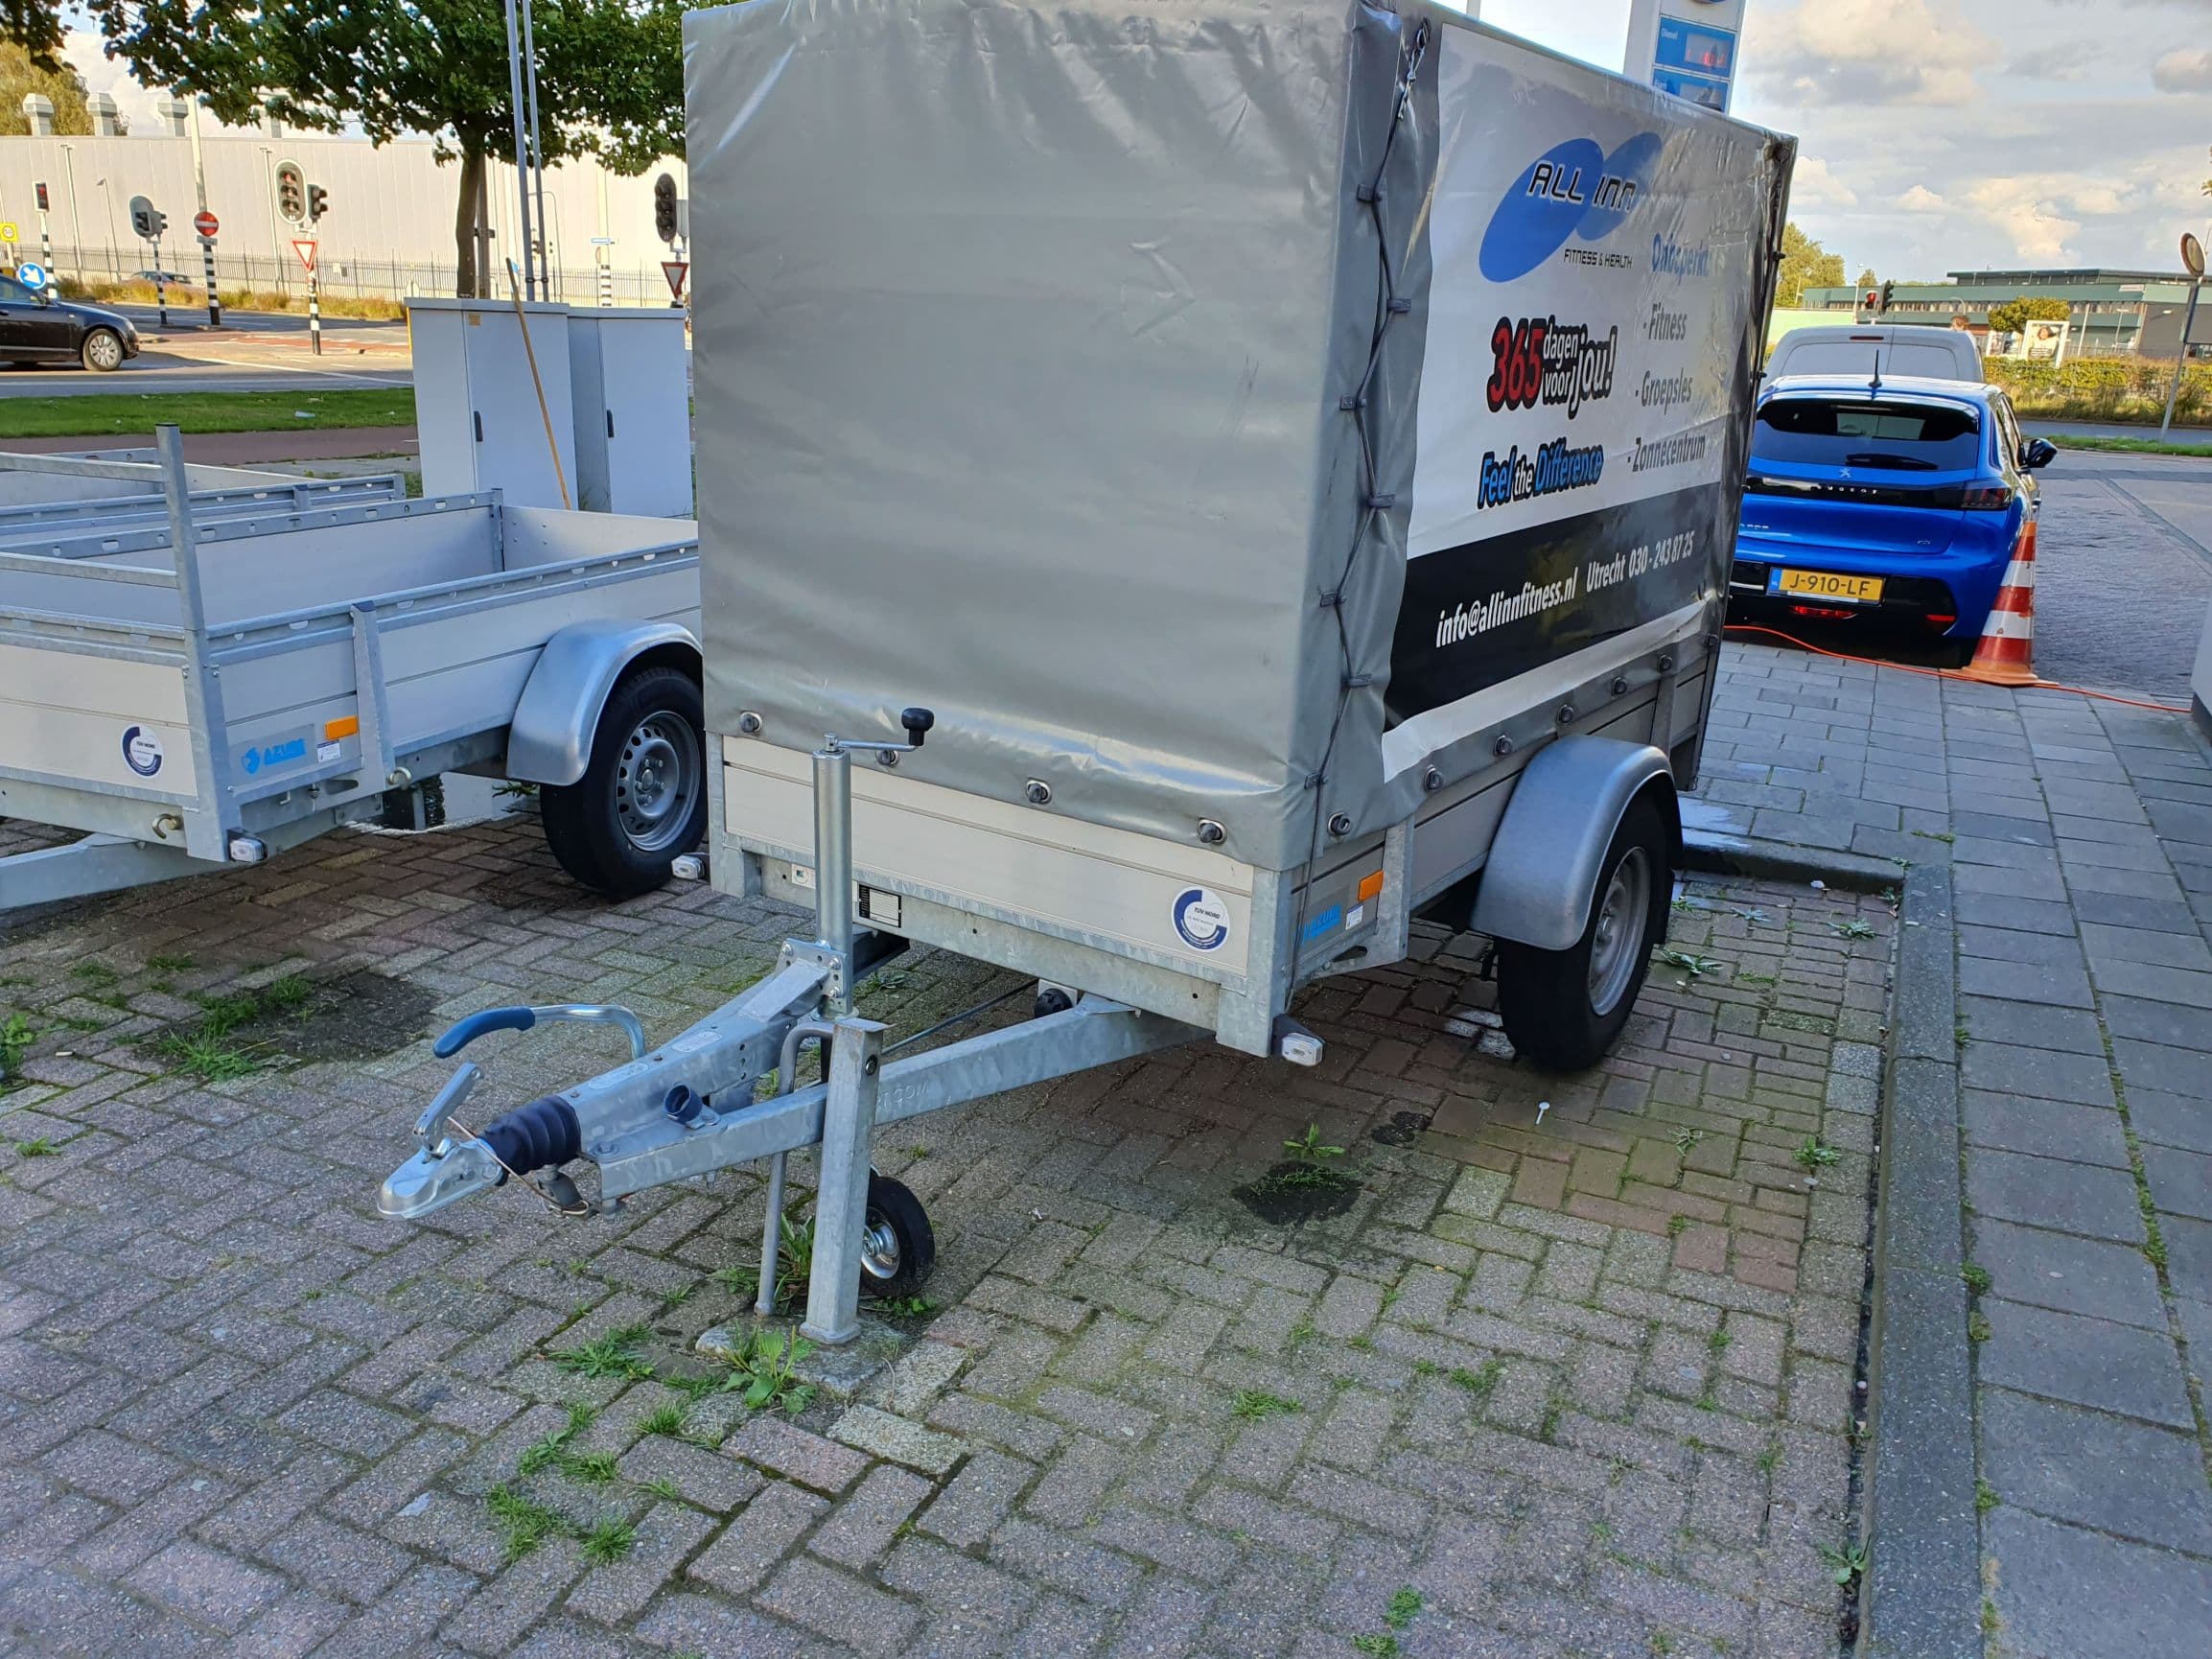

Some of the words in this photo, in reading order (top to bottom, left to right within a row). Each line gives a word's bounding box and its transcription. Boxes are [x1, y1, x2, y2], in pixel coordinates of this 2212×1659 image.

[1527, 161, 1583, 203] ALL
[1604, 253, 1633, 269] HEALTH
[1648, 302, 1688, 340] Fitness
[1488, 320, 1545, 409] 365
[1543, 322, 1579, 370] dagen
[1544, 370, 1572, 398] voor
[1641, 367, 1693, 415] Groepsles
[1479, 448, 1517, 506] Feel
[1514, 459, 1534, 497] the
[1534, 440, 1604, 494] Difference
[1632, 432, 1706, 473] Zonnecentrum
[1435, 566, 1579, 648] info@allinnfitness.nl
[1587, 552, 1626, 593] Utrecht
[1629, 545, 1649, 579] 030
[1789, 573, 1871, 596] J-910-LF
